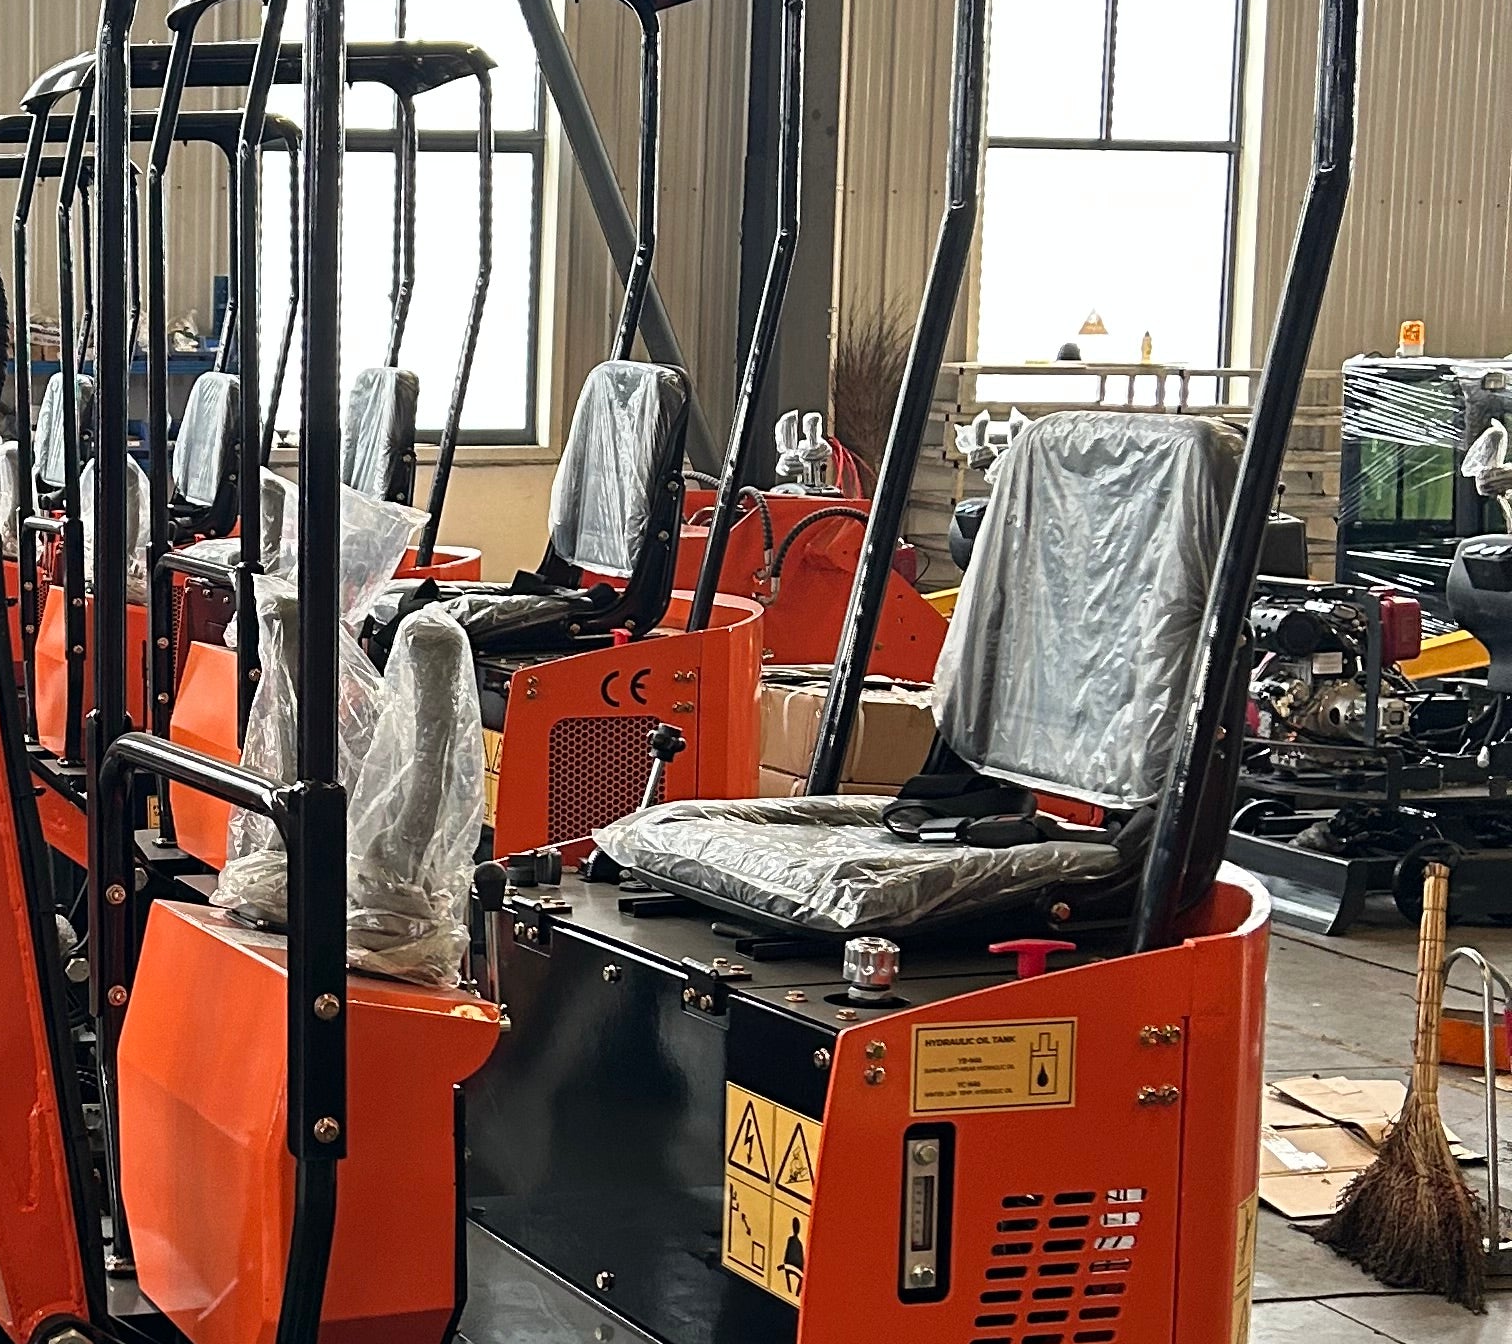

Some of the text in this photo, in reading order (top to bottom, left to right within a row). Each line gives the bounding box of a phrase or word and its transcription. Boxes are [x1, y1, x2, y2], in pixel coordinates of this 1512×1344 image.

[600, 668, 652, 708] CE
[924, 1035, 1016, 1047] HYDRAULIC OIL TANK
